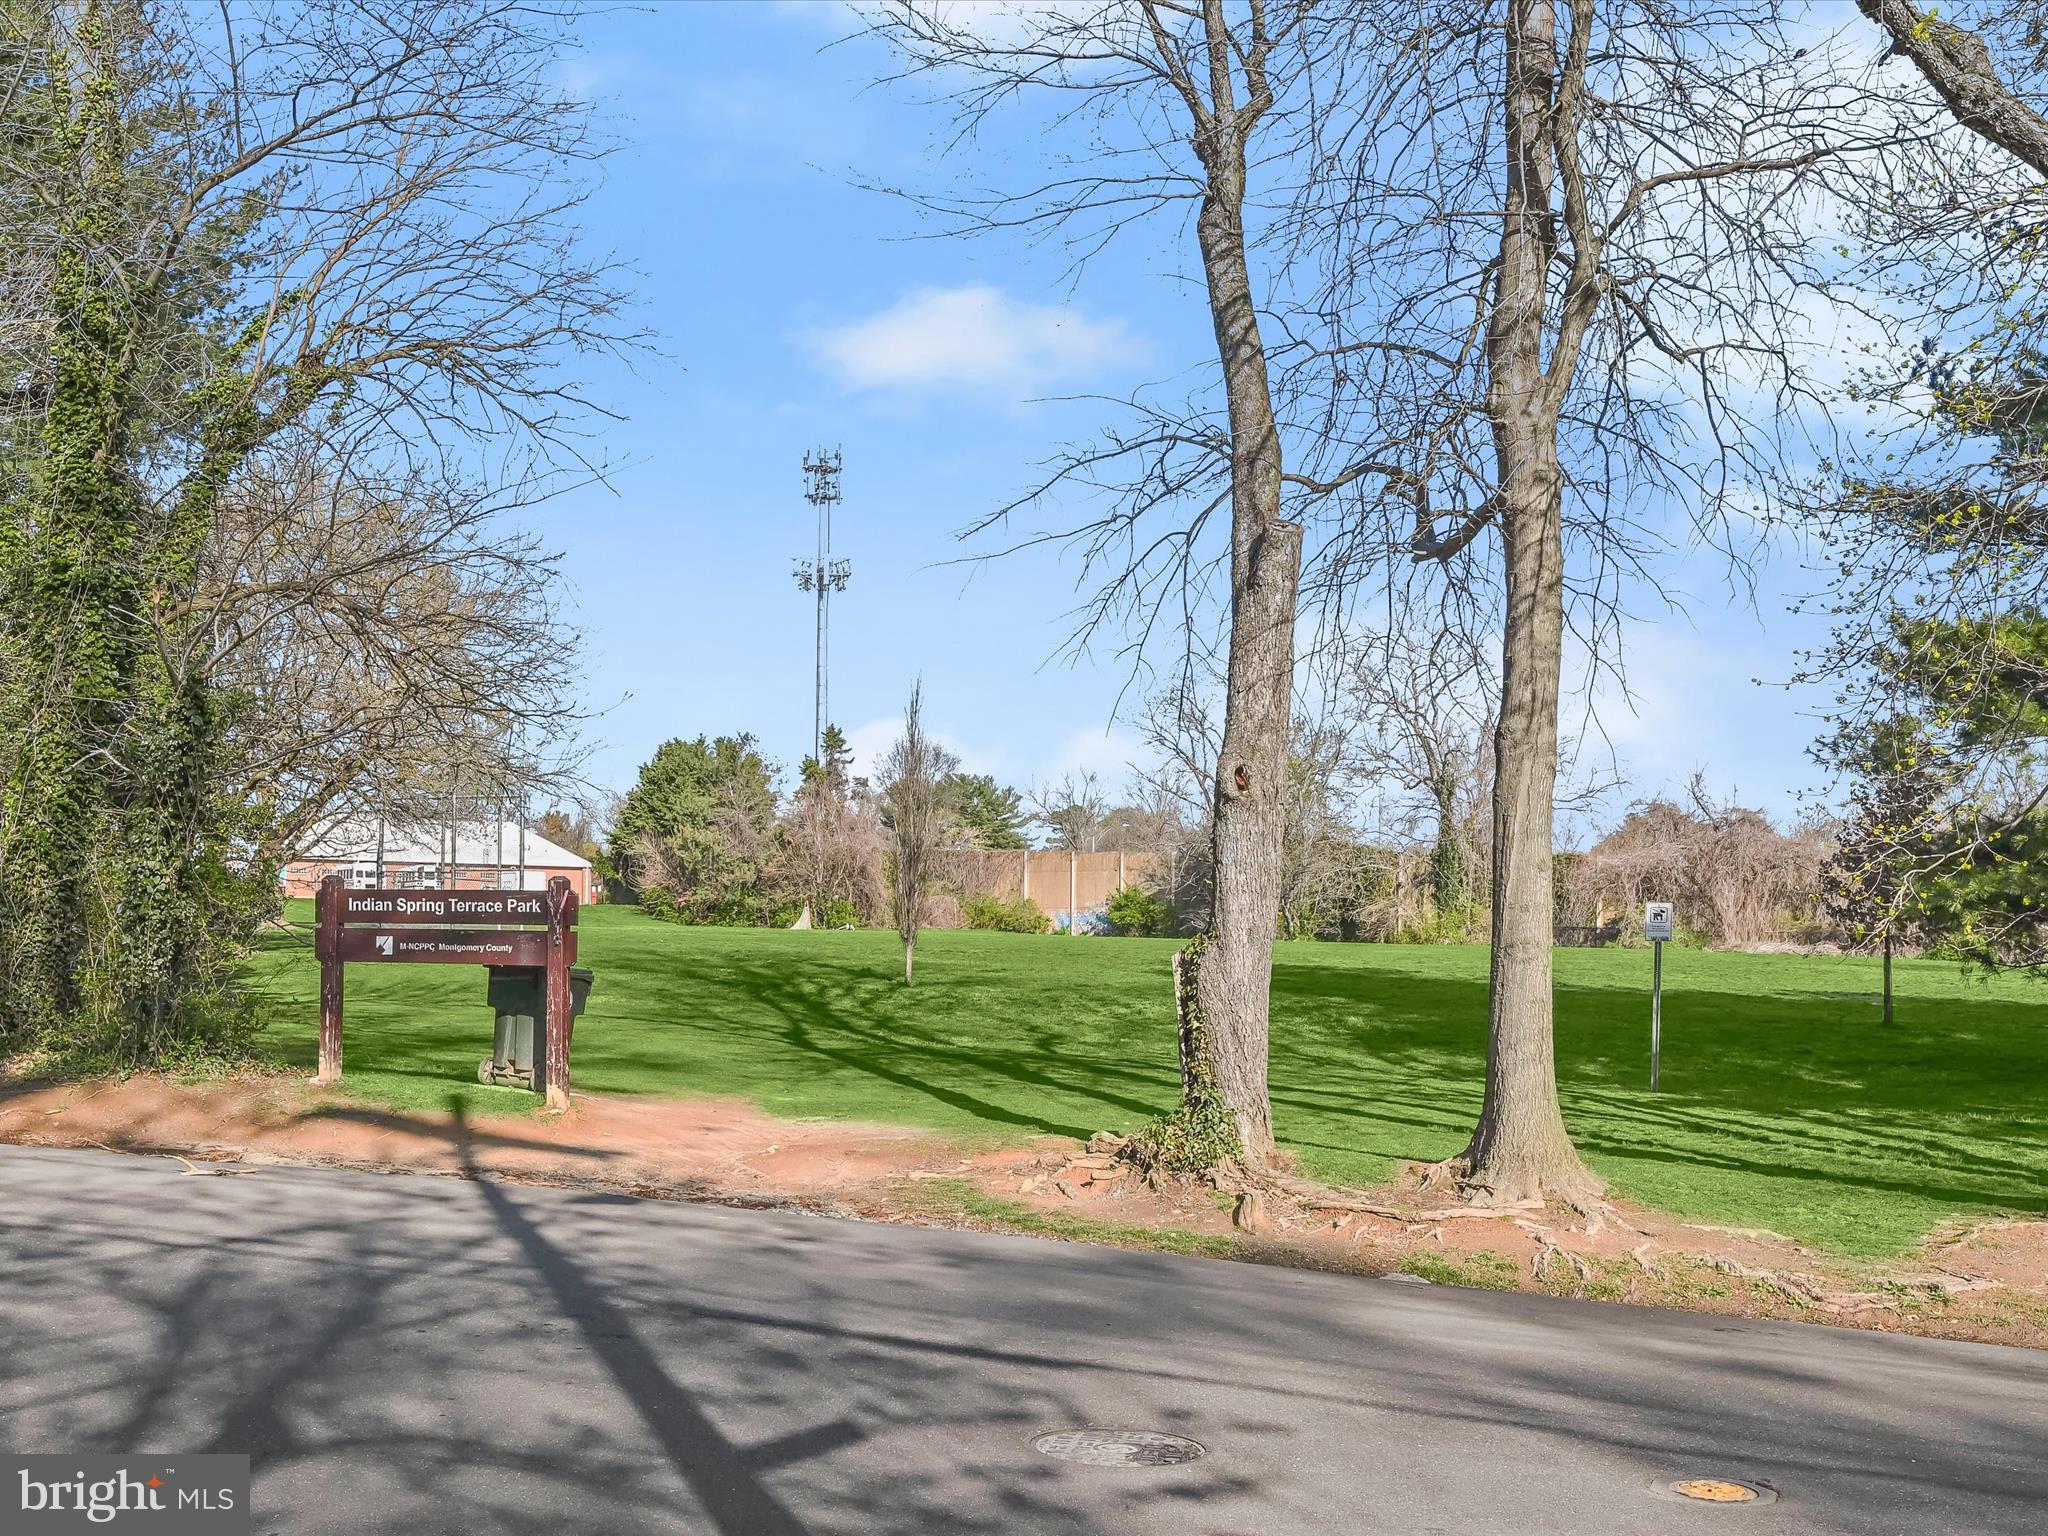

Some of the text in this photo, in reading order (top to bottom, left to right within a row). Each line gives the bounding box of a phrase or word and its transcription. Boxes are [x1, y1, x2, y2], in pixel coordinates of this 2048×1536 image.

[348, 897, 541, 916] Indian Spring Terrace Park
[438, 943, 485, 953] Montgomery
[485, 943, 513, 954] County
